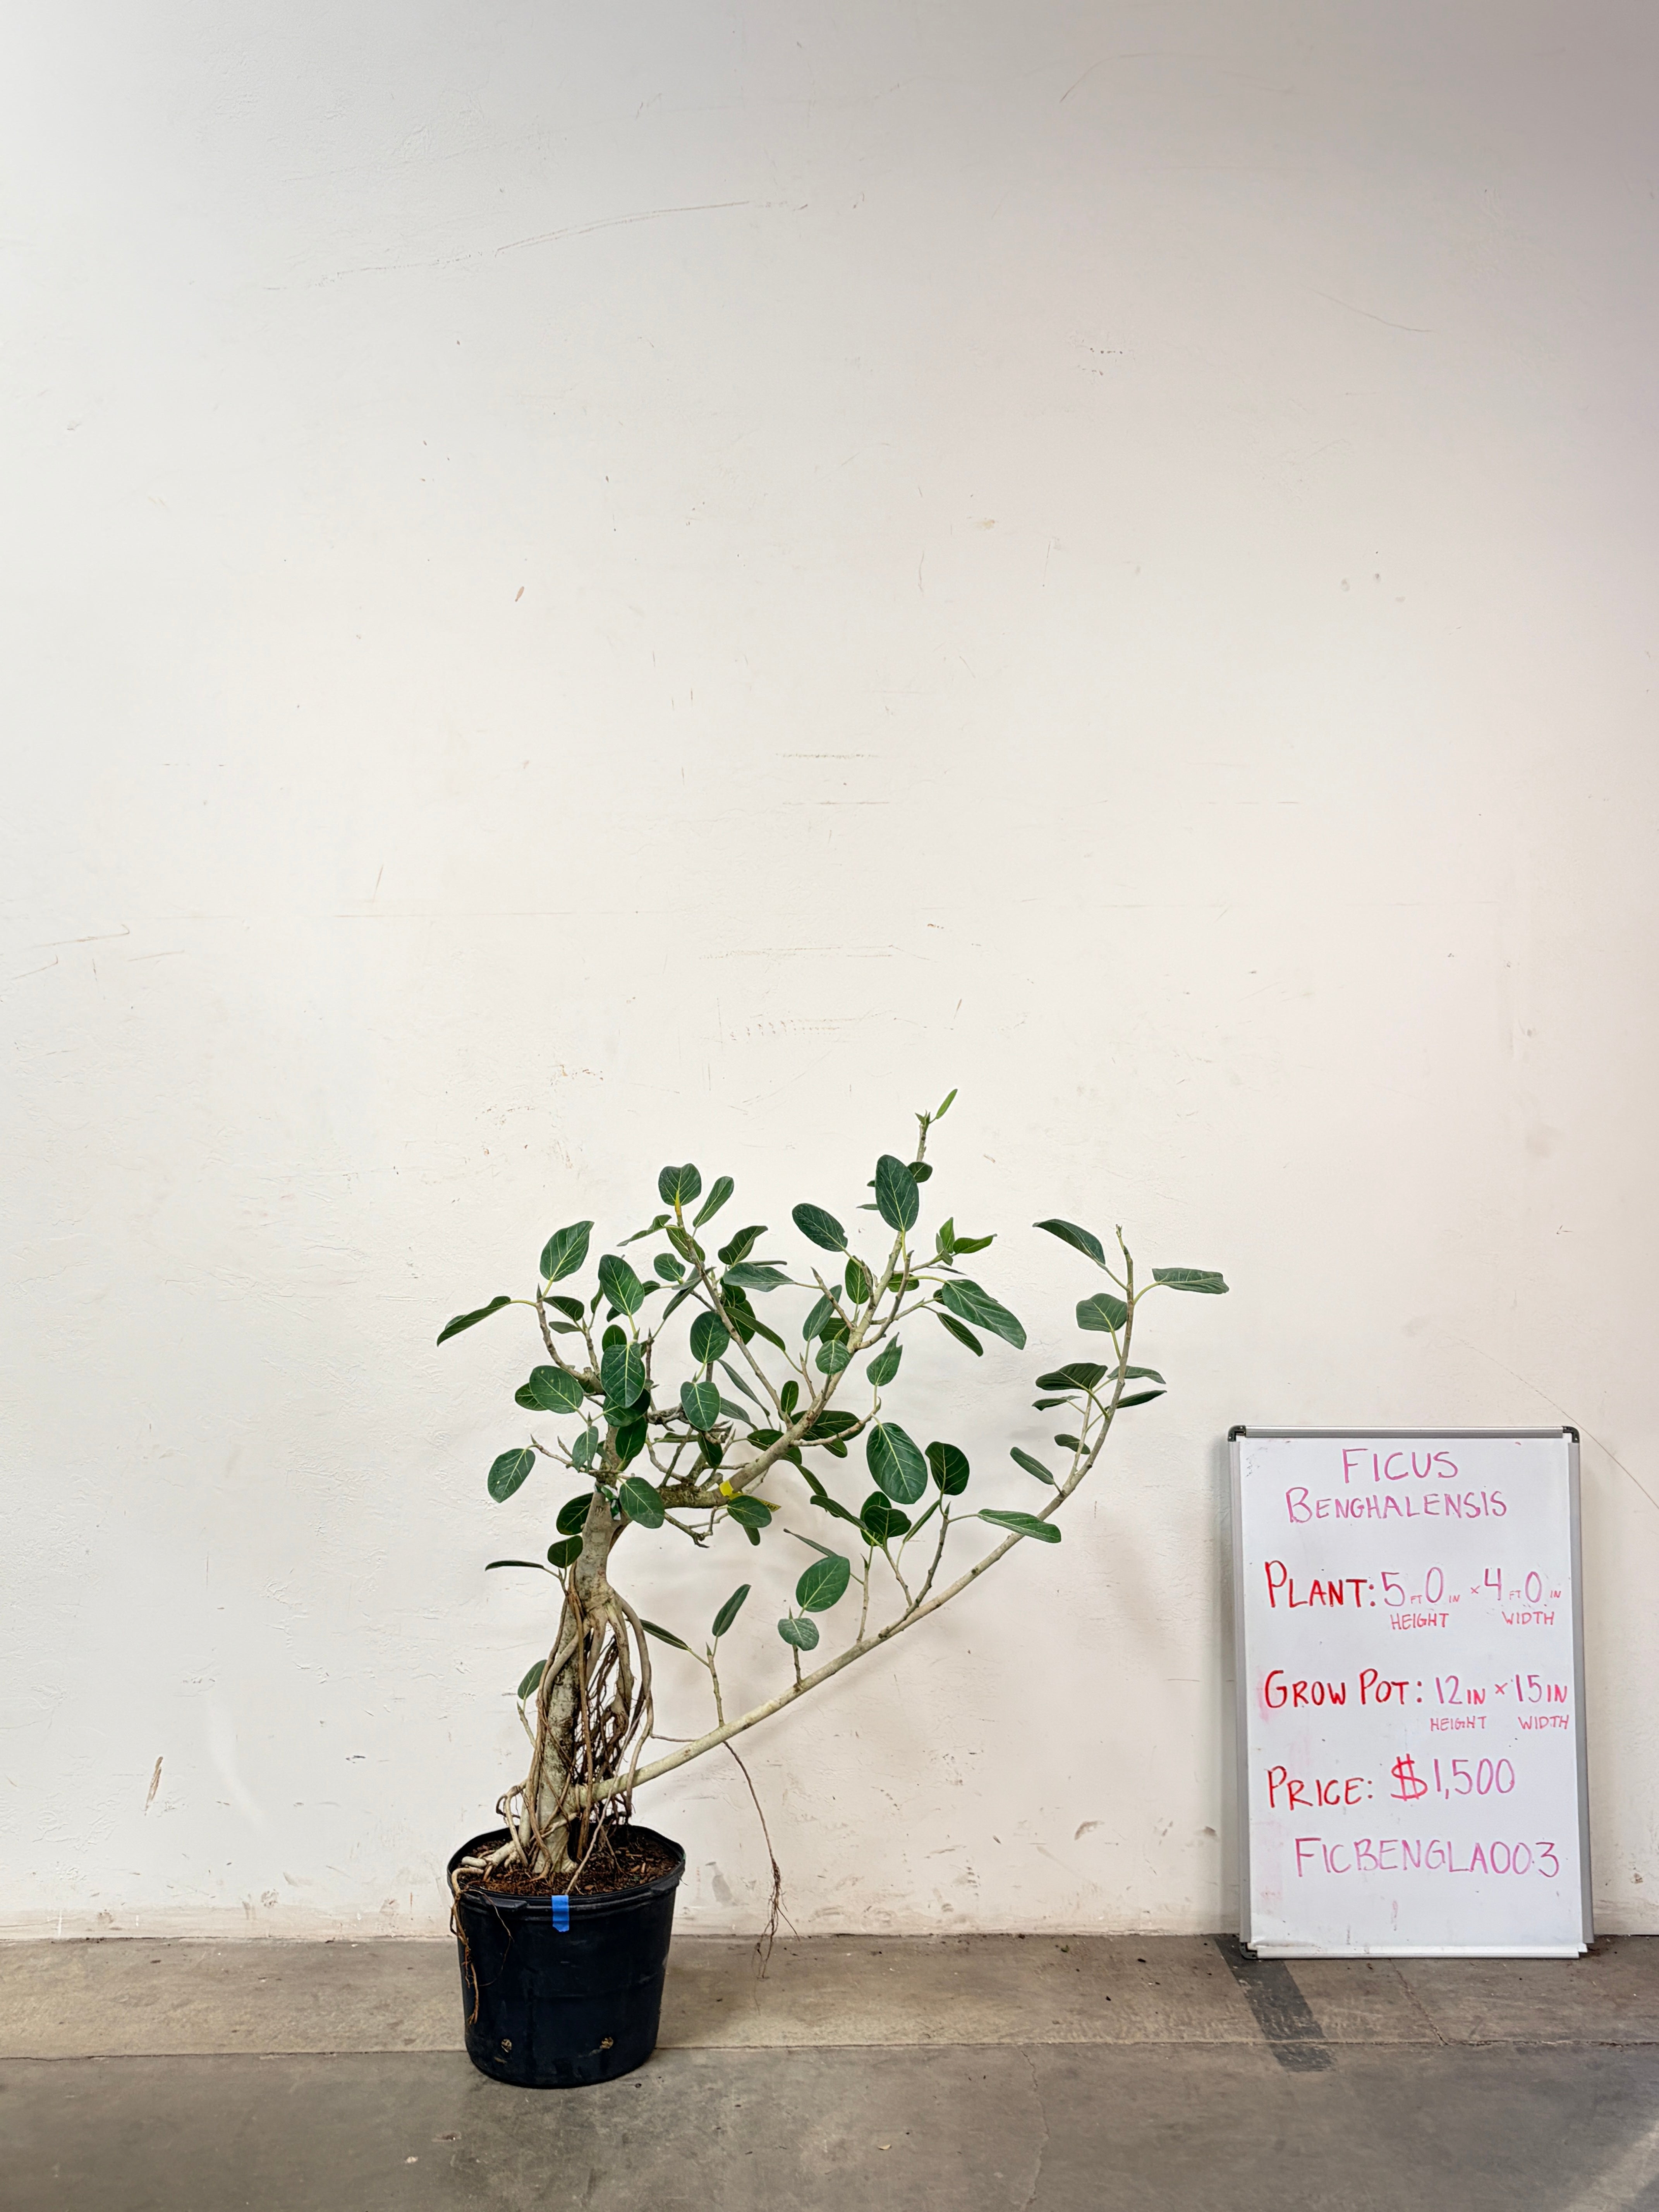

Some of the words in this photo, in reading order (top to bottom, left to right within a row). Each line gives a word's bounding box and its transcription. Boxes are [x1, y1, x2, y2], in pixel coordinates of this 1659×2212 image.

[1342, 1449, 1458, 1484] FICUS
[1286, 1487, 1507, 1523] BENGHALENSIS
[1264, 1561, 1375, 1608] PLANT:
[1381, 1571, 1405, 1607] 5
[1391, 1613, 1448, 1630] HEIGHT
[1502, 1611, 1554, 1625] WIDTH
[1263, 1670, 1346, 1710] GROW
[1358, 1669, 1422, 1705] POT:
[1430, 1716, 1486, 1731] HEIGHT
[1518, 1716, 1569, 1730] WIDTH
[1267, 1766, 1372, 1811] PRICE:
[1391, 1753, 1515, 1802] $1,500
[1295, 1837, 1559, 1877] FICBENGLA003
